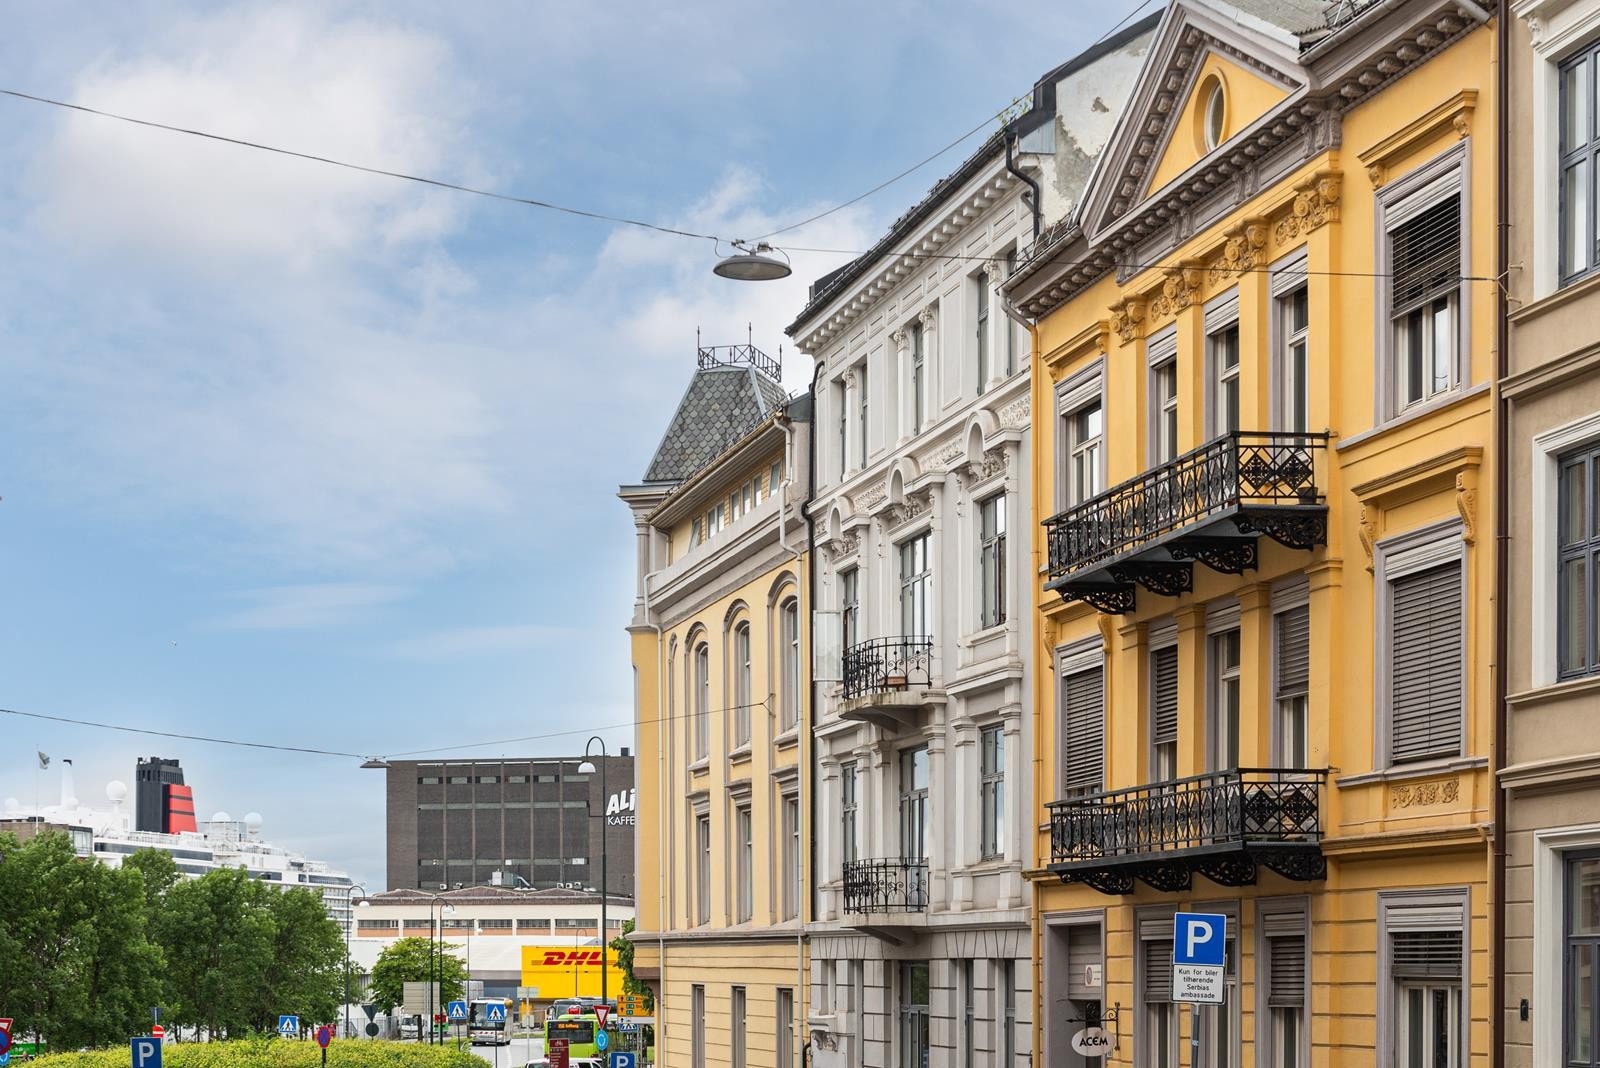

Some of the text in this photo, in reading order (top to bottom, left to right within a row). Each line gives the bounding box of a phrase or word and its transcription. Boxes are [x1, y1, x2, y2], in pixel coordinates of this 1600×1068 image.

[608, 816, 636, 825] KAFFE
[1186, 920, 1213, 958] P
[542, 951, 604, 966] DHL
[1193, 968, 1203, 976] for
[1205, 969, 1218, 977] biler
[1183, 976, 1214, 984] tilhørende
[1186, 983, 1210, 991] Serbias
[1180, 991, 1216, 999] ambassade
[1079, 1036, 1109, 1047] ACEM
[138, 1042, 155, 1067] P
[616, 1055, 629, 1068] P
